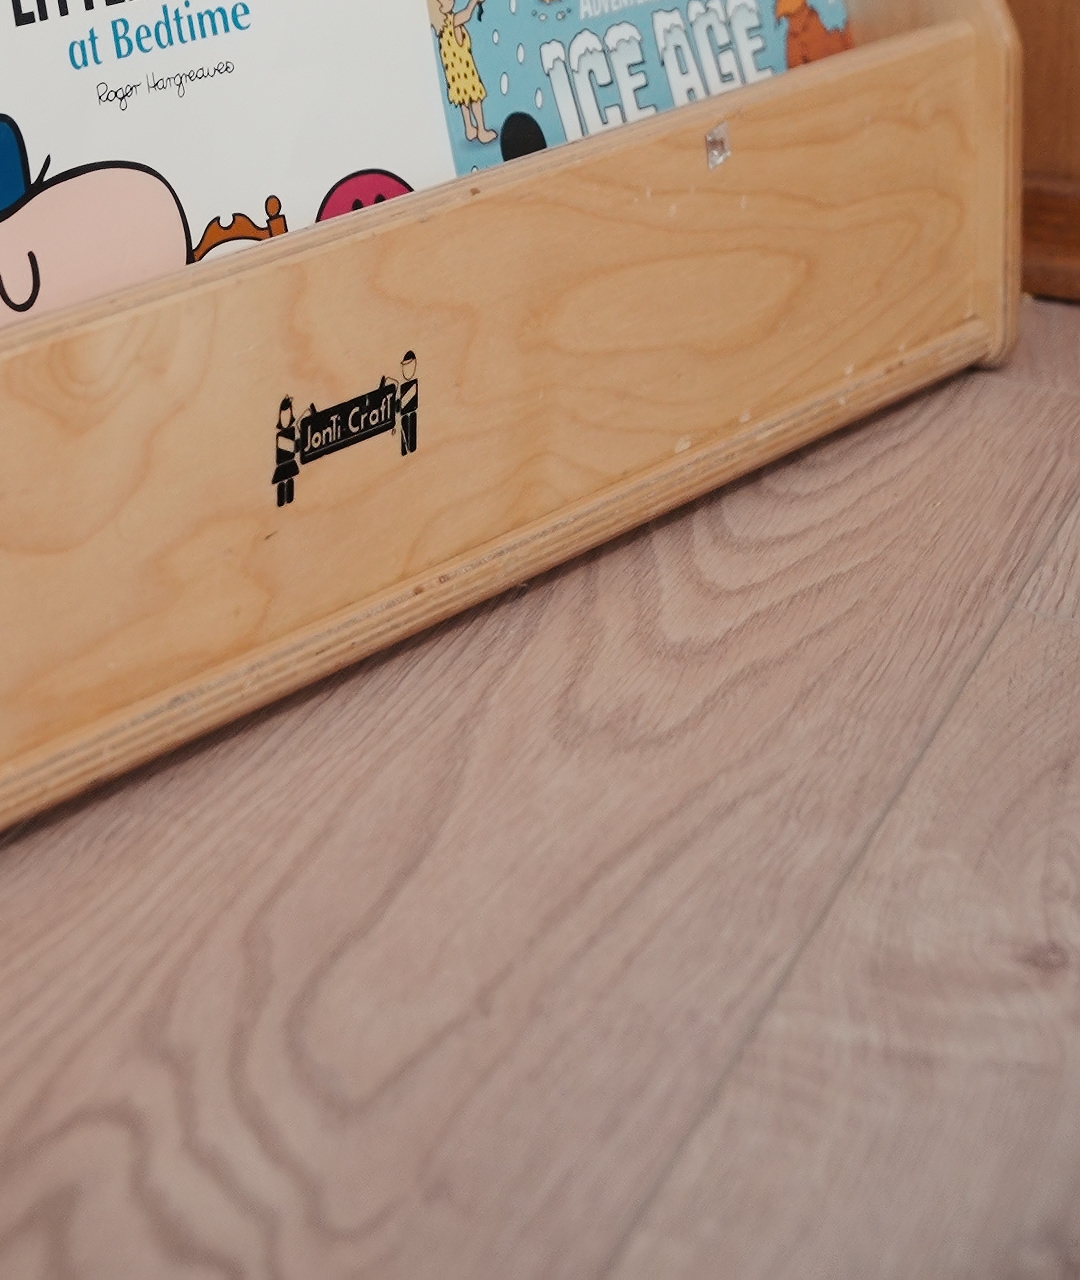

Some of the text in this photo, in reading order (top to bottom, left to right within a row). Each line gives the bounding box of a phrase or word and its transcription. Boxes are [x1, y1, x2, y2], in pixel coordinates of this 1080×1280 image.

[68, 0, 252, 71] at Bedtime
[96, 60, 235, 111] Roger Hargreaves
[539, 20, 657, 143] ICE
